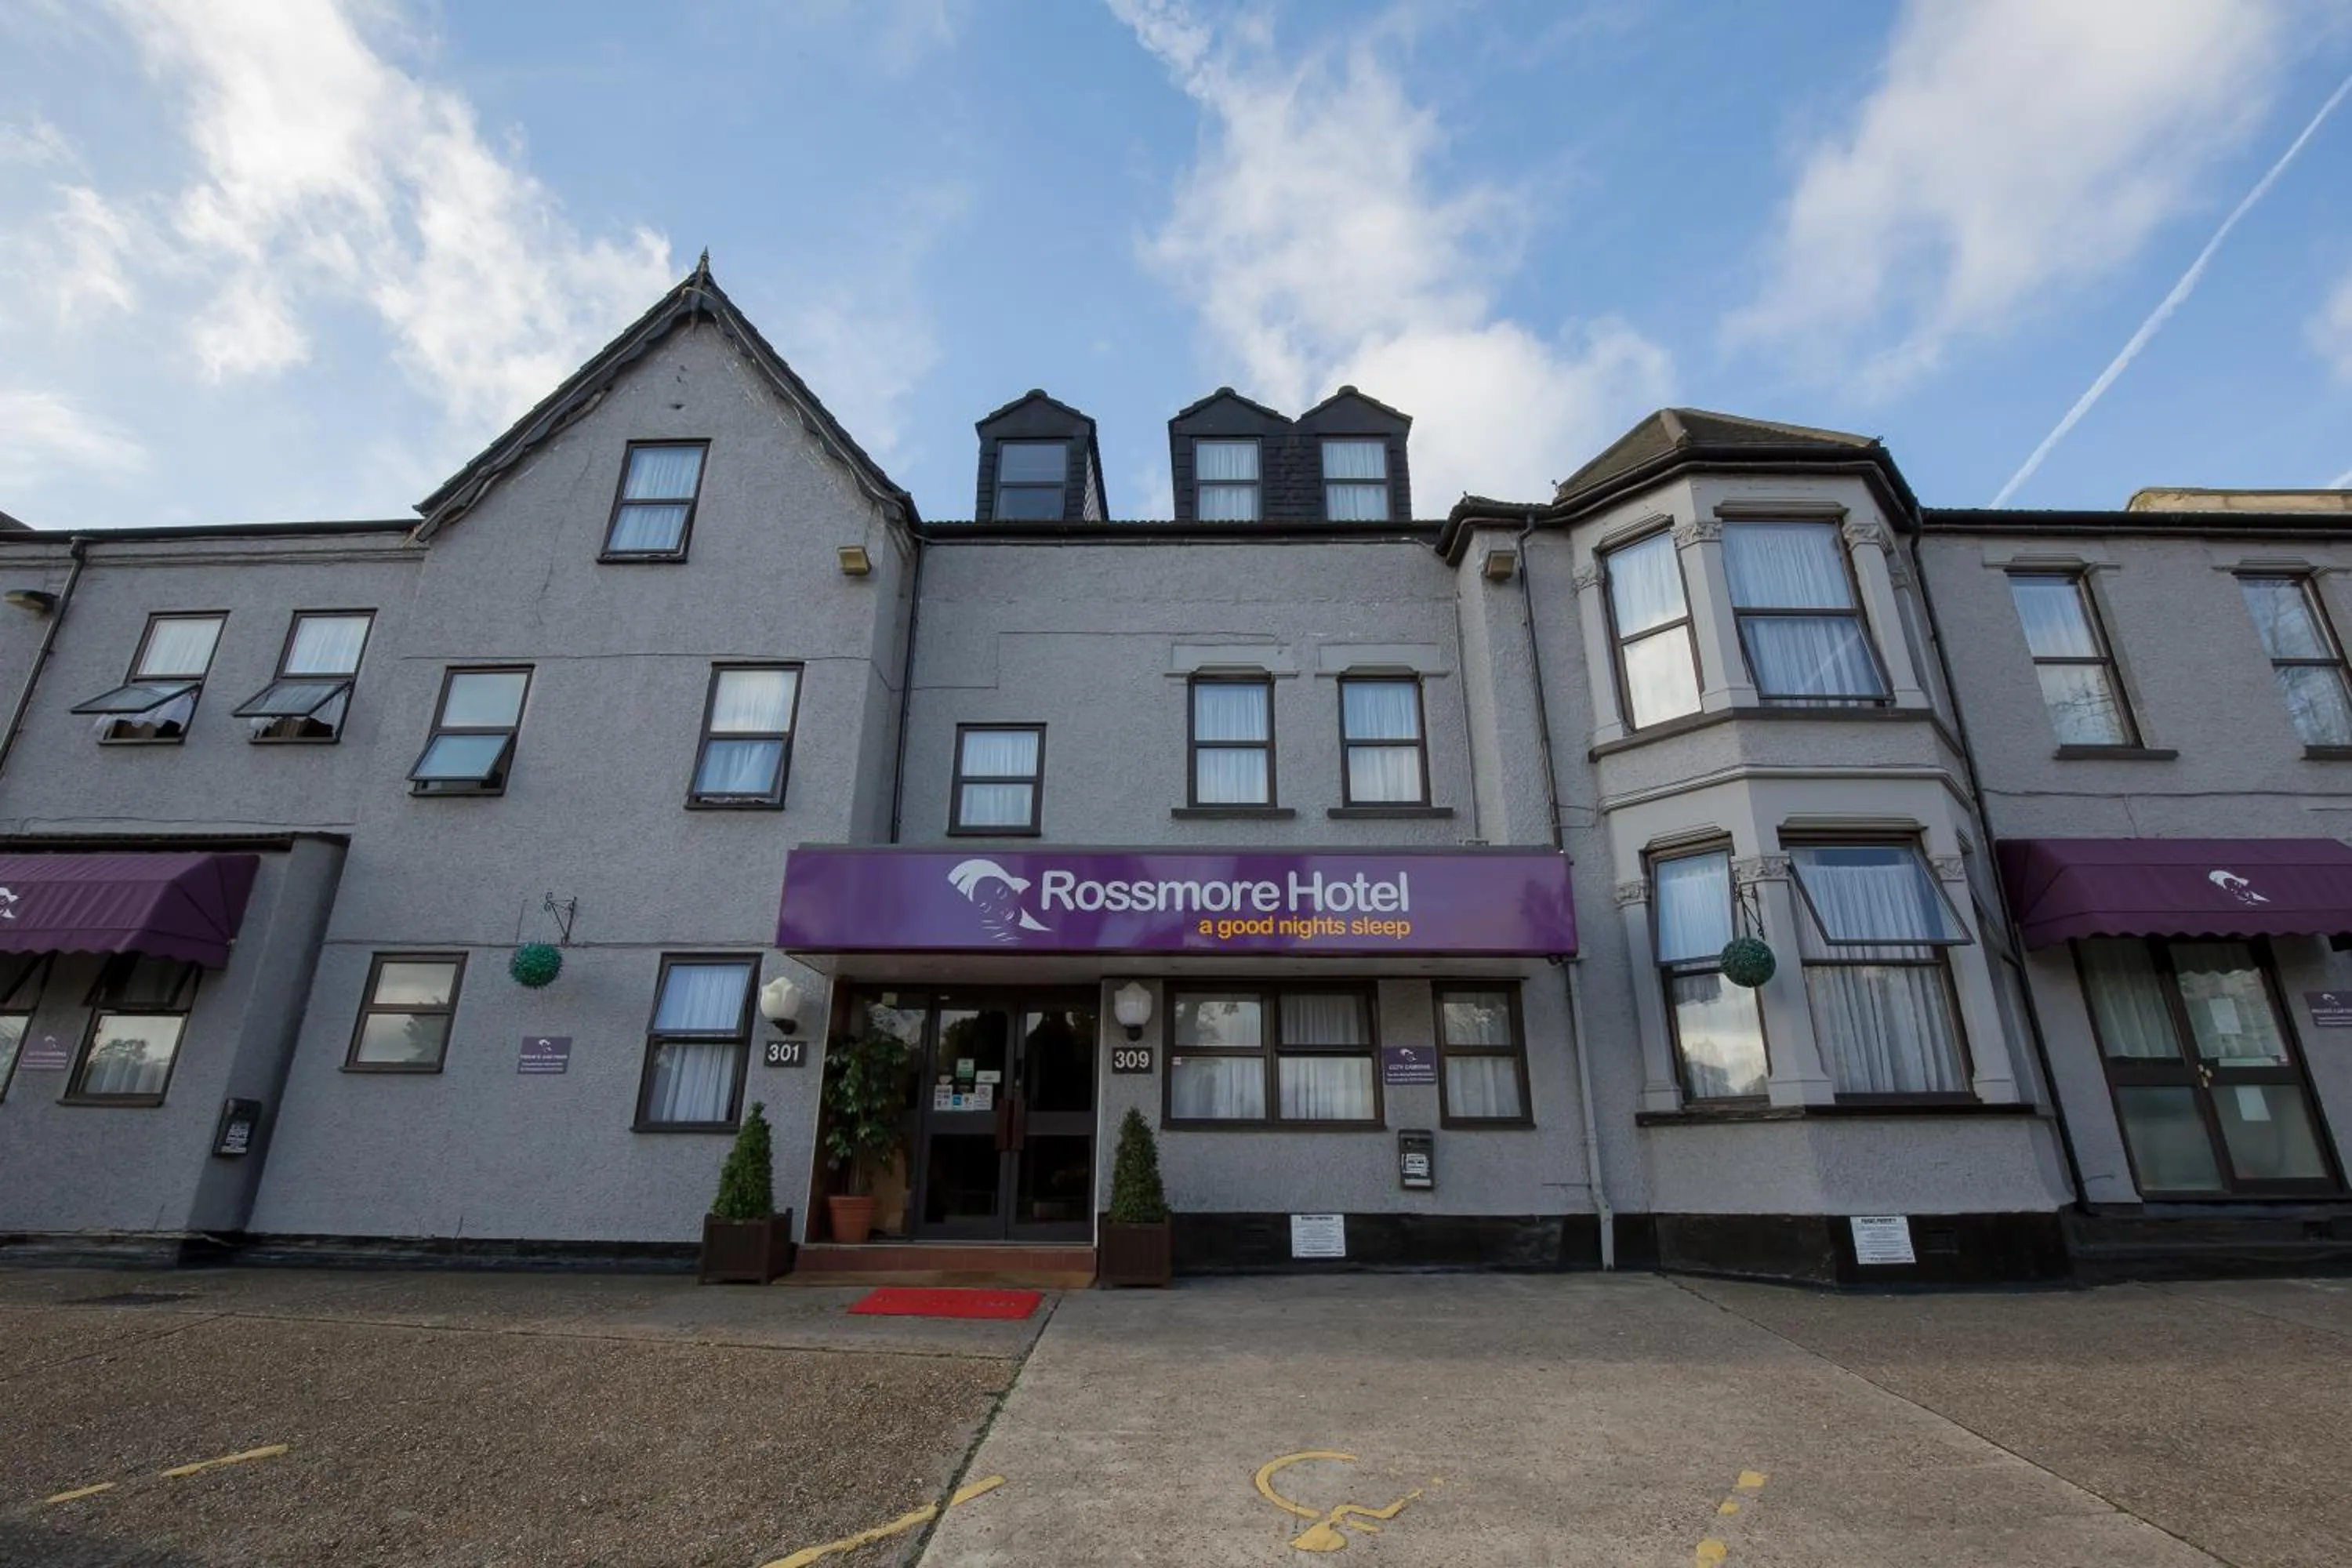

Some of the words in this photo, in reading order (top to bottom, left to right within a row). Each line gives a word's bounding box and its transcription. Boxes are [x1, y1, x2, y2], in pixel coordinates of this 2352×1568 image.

[1041, 870, 1280, 912] Rossmore
[1288, 871, 1409, 912] Hotel
[1199, 919, 1213, 935] a
[1218, 916, 1274, 939] good
[1279, 916, 1346, 939] nights
[1351, 916, 1410, 939] sleep
[768, 1044, 800, 1062] 301
[1114, 1051, 1149, 1069] 309
